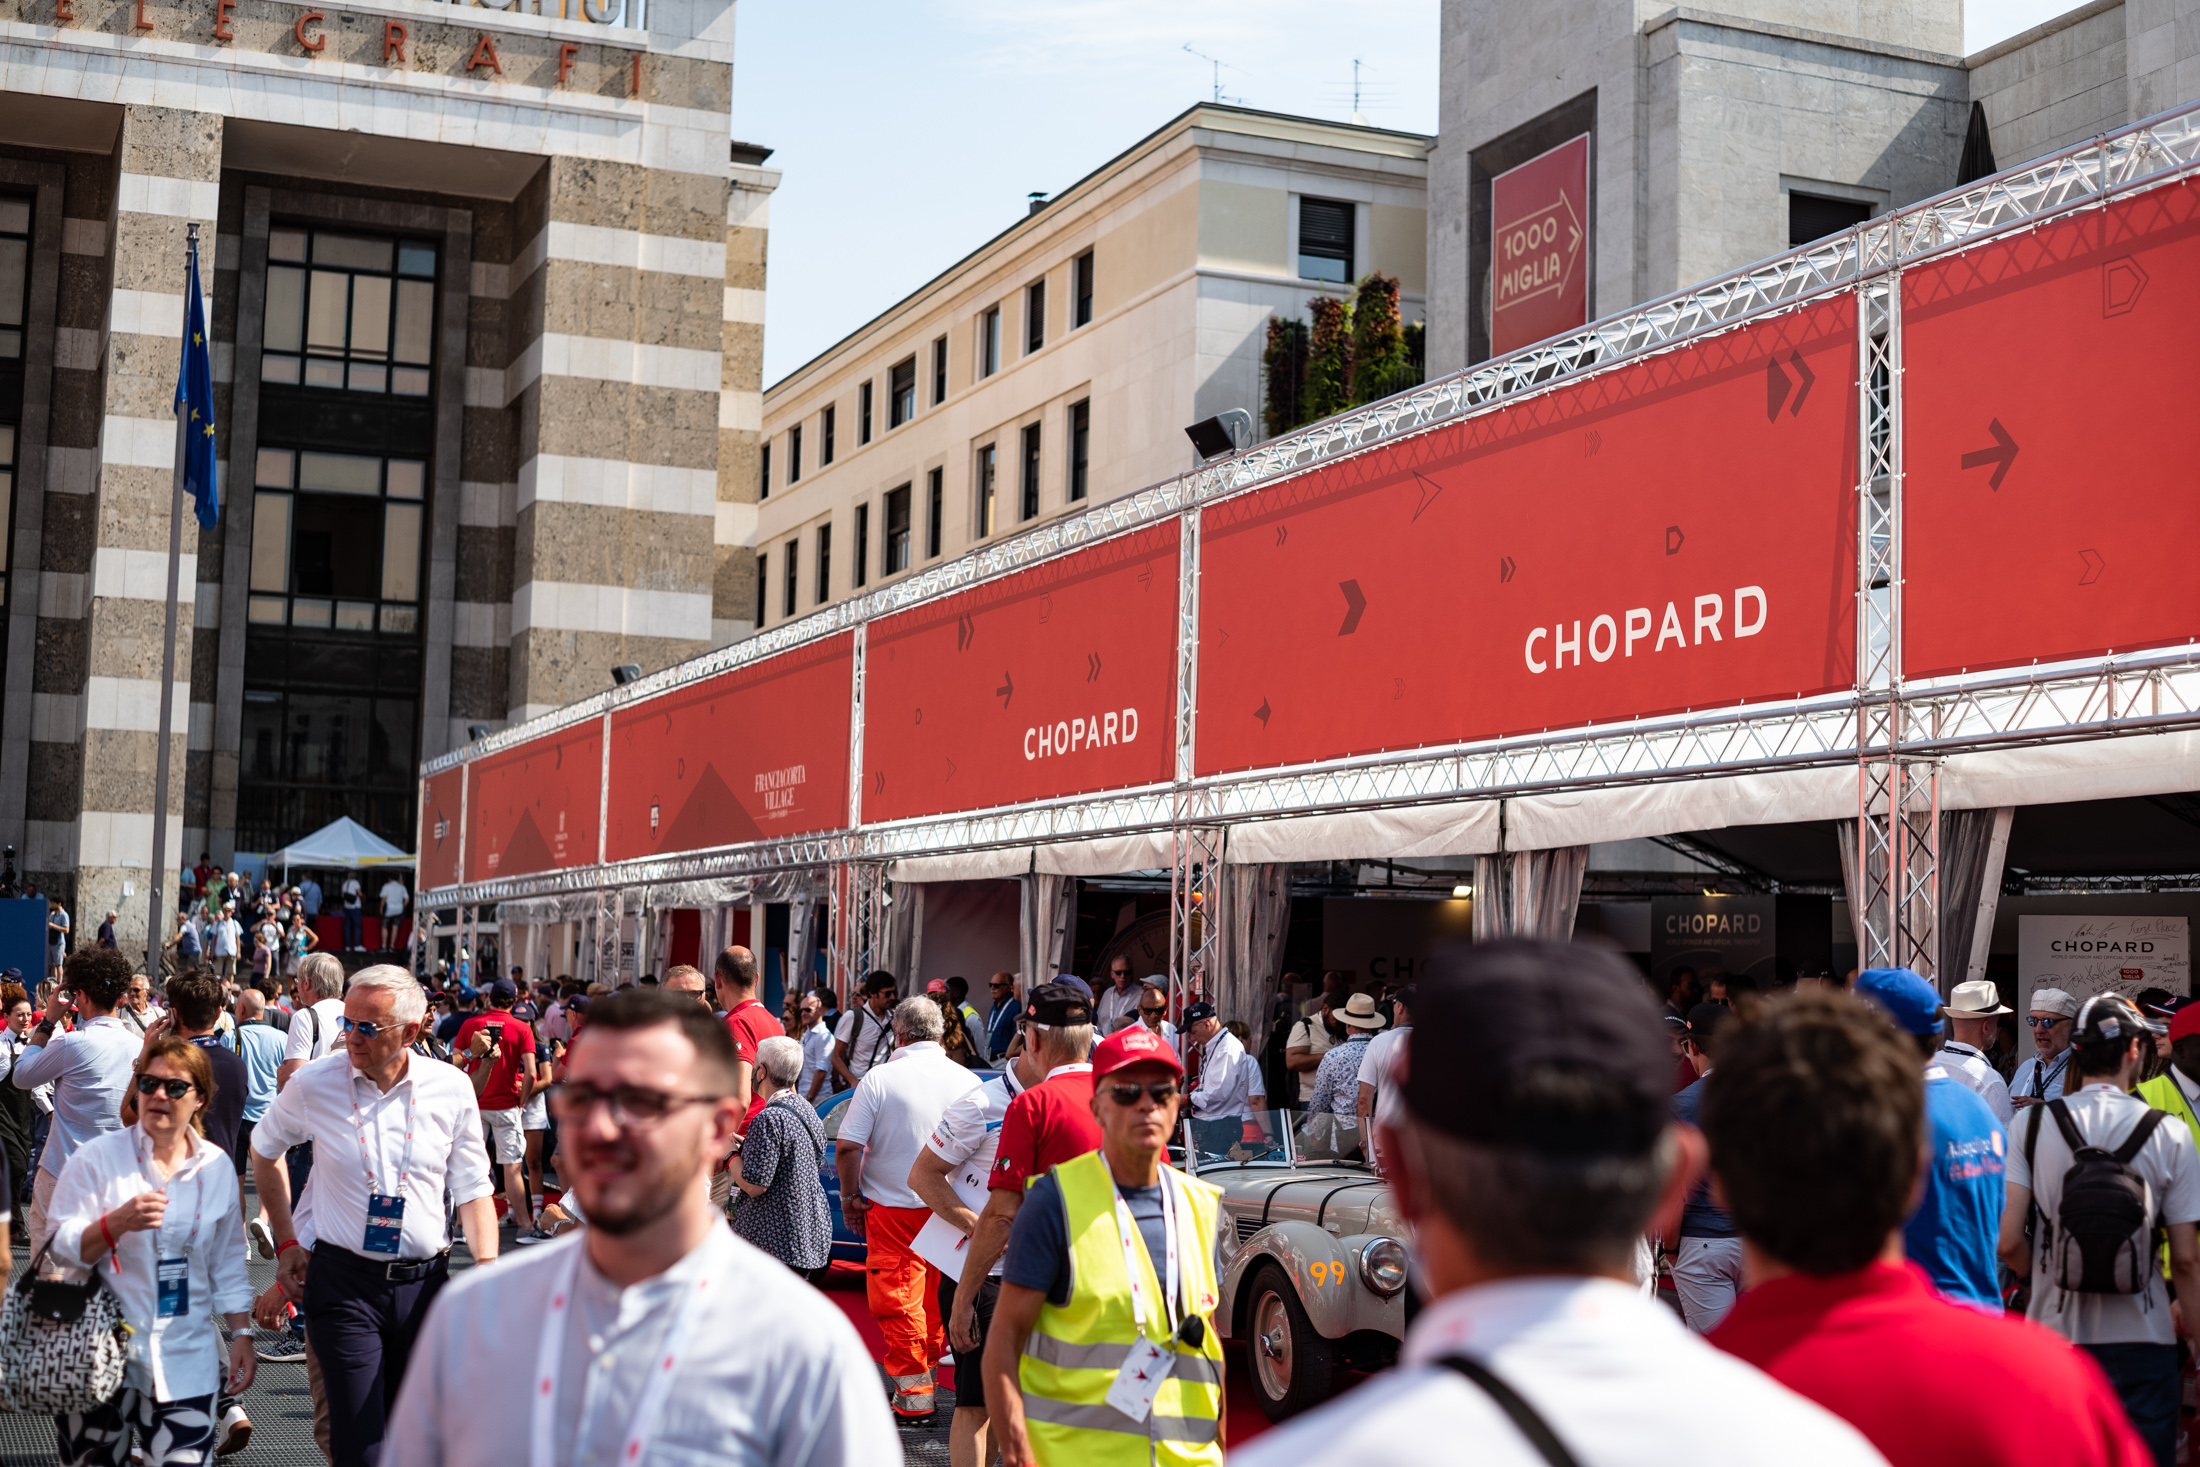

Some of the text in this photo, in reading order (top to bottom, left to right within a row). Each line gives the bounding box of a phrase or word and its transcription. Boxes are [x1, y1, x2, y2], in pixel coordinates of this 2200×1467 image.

[1504, 216, 1558, 261] 1000
[1499, 251, 1561, 301] MIGLIA
[1524, 584, 1768, 675] CHOPARD
[1023, 707, 1139, 761] CHOPARD
[754, 764, 807, 793] FRANCIACORTA
[764, 787, 795, 811] VILLAGE
[1666, 914, 1761, 934] CHOPARD
[2050, 940, 2155, 953] CHOPARD
[1309, 1260, 1346, 1287] 99
